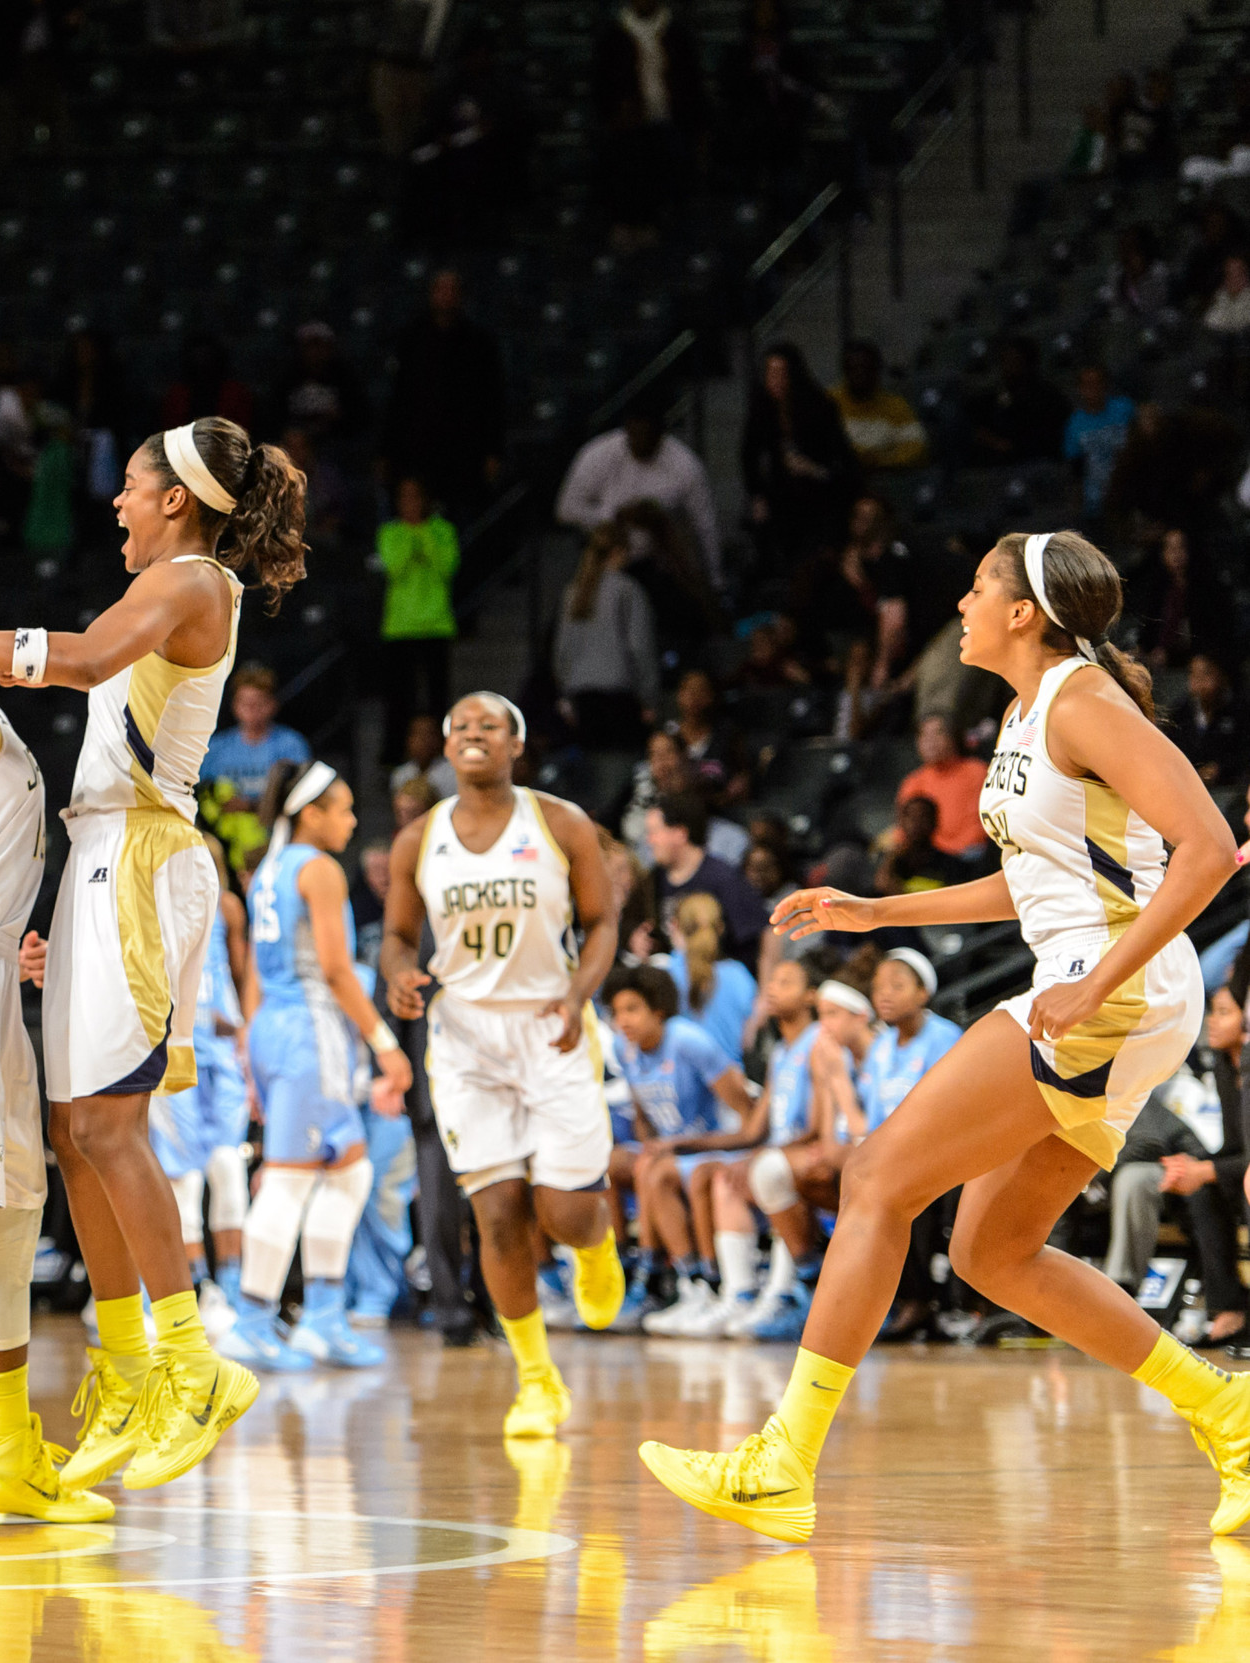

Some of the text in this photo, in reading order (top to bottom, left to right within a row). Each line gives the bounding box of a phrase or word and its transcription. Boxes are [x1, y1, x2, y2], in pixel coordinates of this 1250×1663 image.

[984, 751, 1032, 797] CKETS
[440, 877, 537, 919] JACKETS
[461, 921, 514, 961] 40
